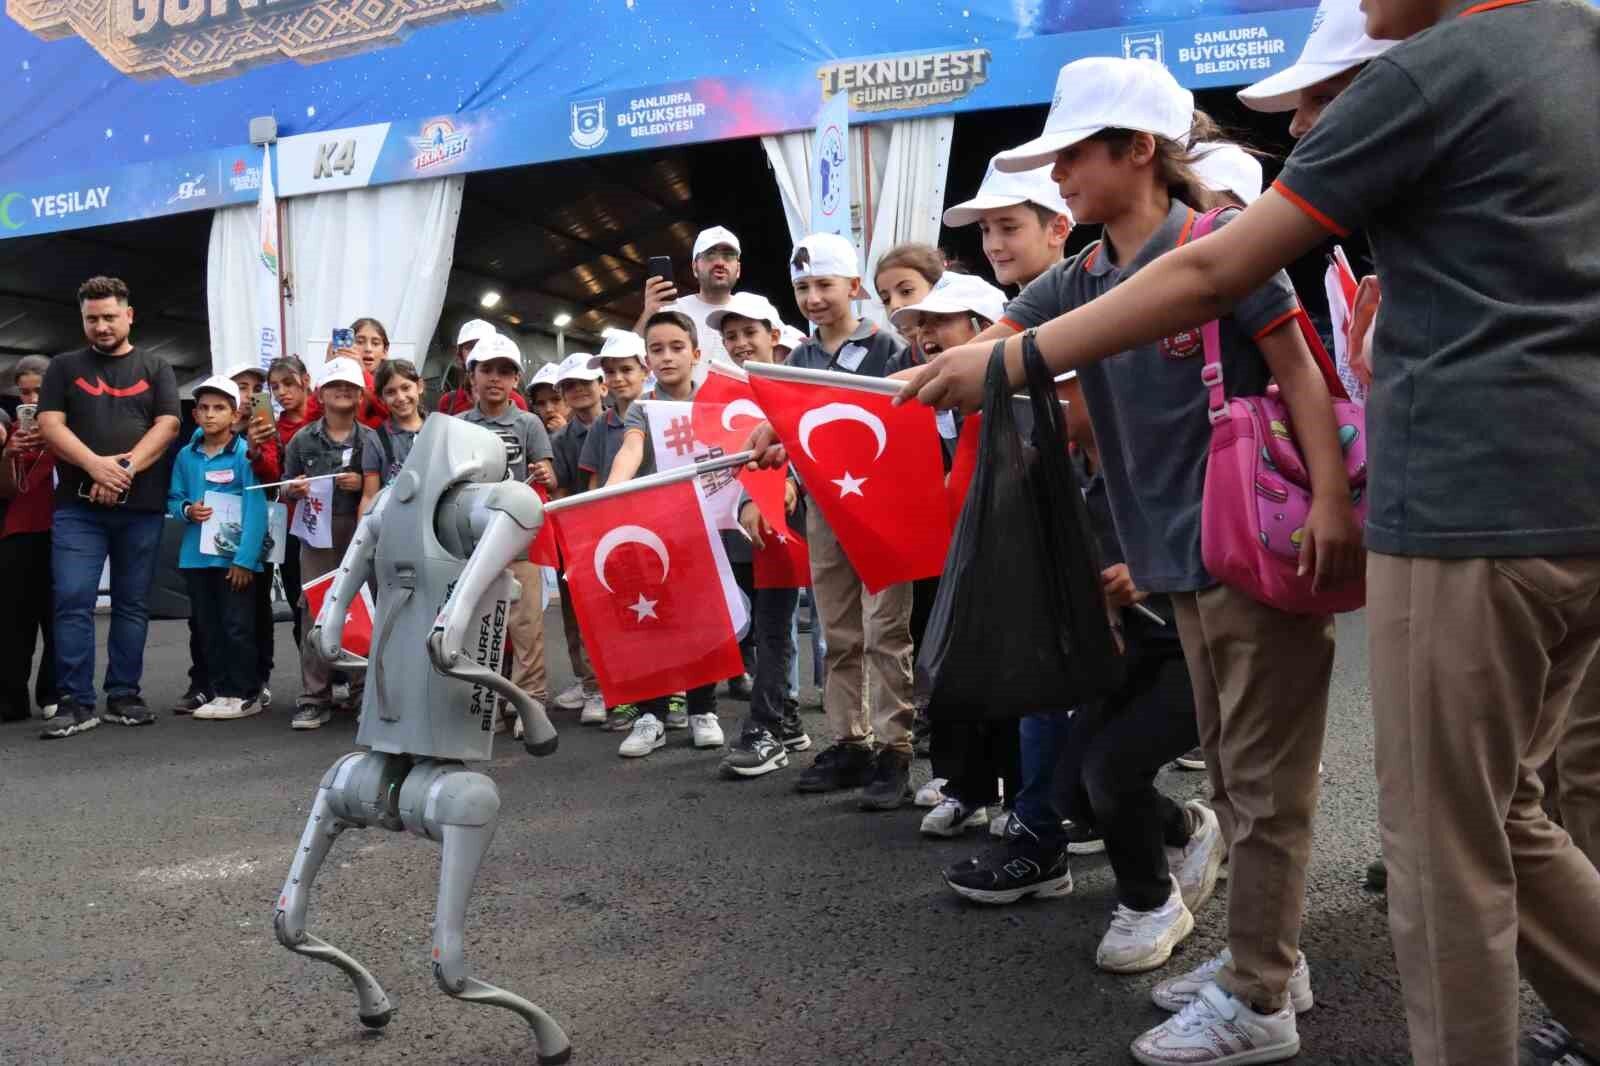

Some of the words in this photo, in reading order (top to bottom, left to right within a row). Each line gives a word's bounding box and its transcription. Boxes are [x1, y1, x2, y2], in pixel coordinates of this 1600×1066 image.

[1194, 26, 1268, 45] ŞANLIURFA
[1178, 39, 1286, 62] BÜYÜKŞEHİR
[817, 49, 991, 94] TEKNOFEST
[1195, 57, 1271, 75] BELEDİYESİ
[630, 92, 693, 112] ŞANLIURFA
[853, 78, 965, 105] GÜNEYDOĞU
[616, 103, 706, 127] BÜYÜKŞEHİR
[630, 119, 694, 137] BELEDİYESİ
[313, 139, 357, 179] K4
[31, 186, 111, 218] YEŞİLAY
